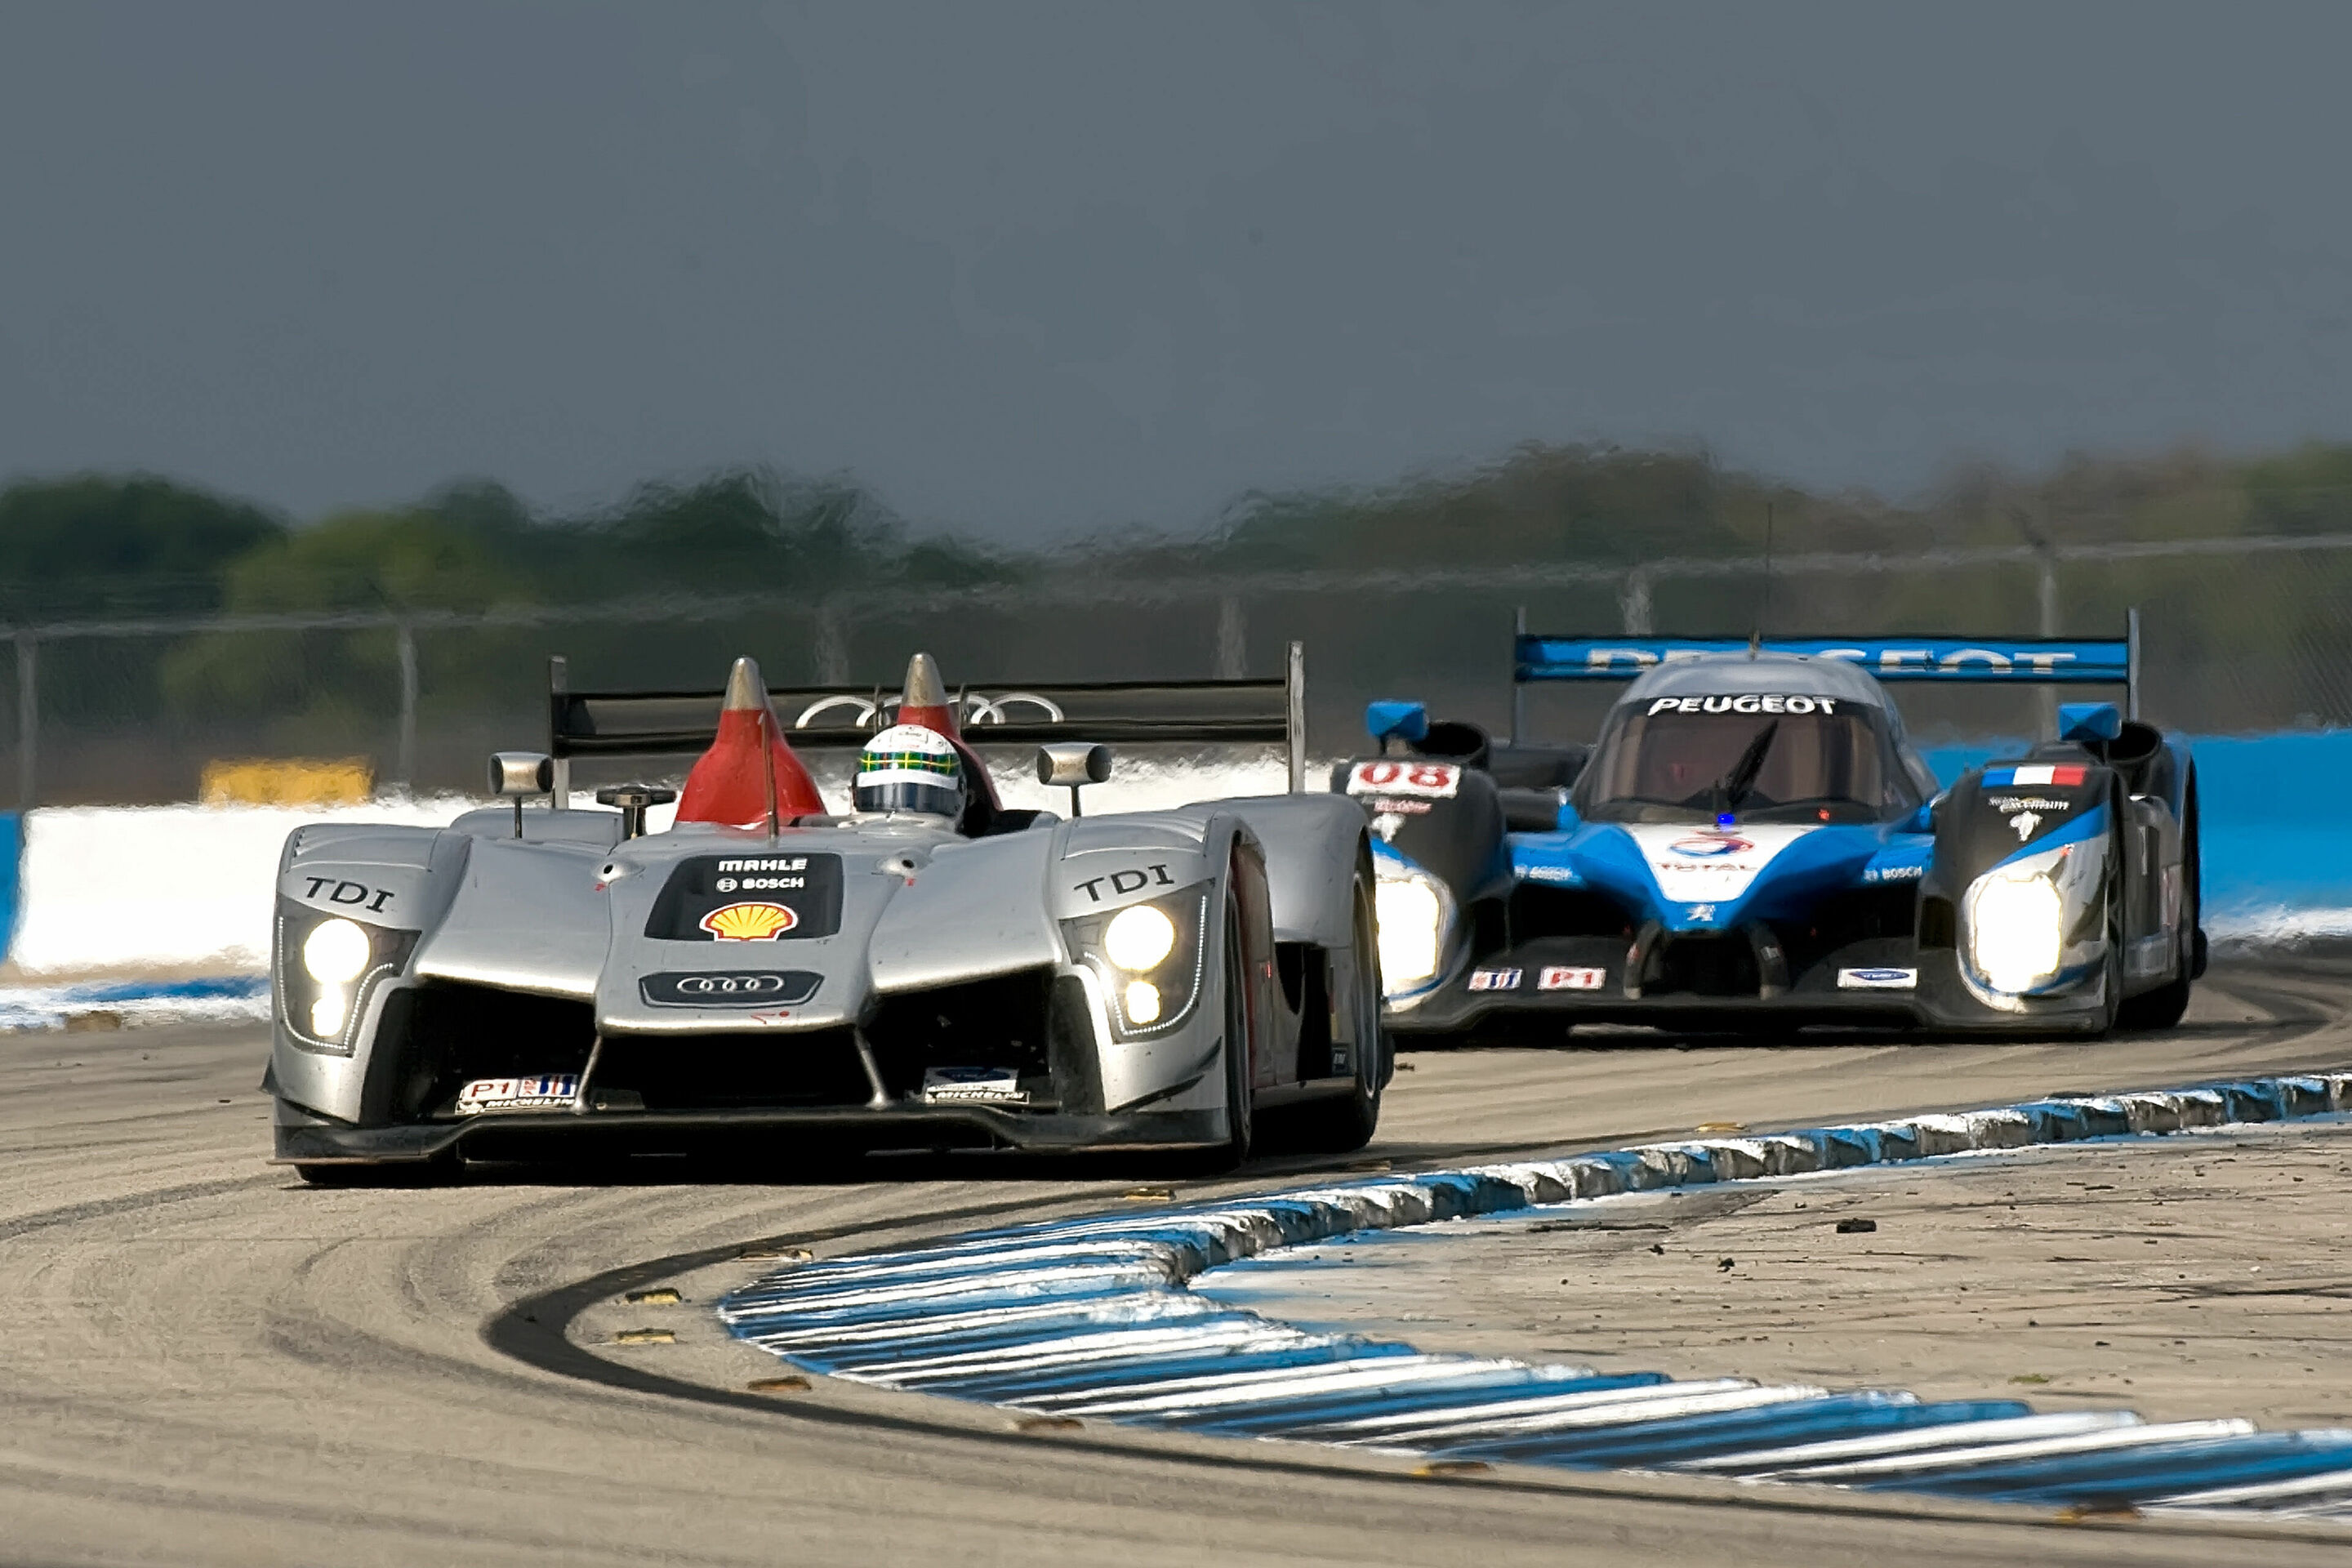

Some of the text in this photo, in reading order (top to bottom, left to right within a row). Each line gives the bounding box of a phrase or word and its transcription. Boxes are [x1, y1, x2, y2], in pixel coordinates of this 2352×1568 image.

[1647, 694, 1836, 716] PEUGEOT
[1360, 763, 1450, 787] 08
[718, 858, 808, 872] MAHLE
[742, 877, 804, 889] BOSCH
[1073, 864, 1175, 902] TDI
[305, 876, 395, 913] TDI
[1551, 971, 1592, 986] P1
[471, 1080, 510, 1098] P1
[485, 1098, 576, 1108] MICHELIN
